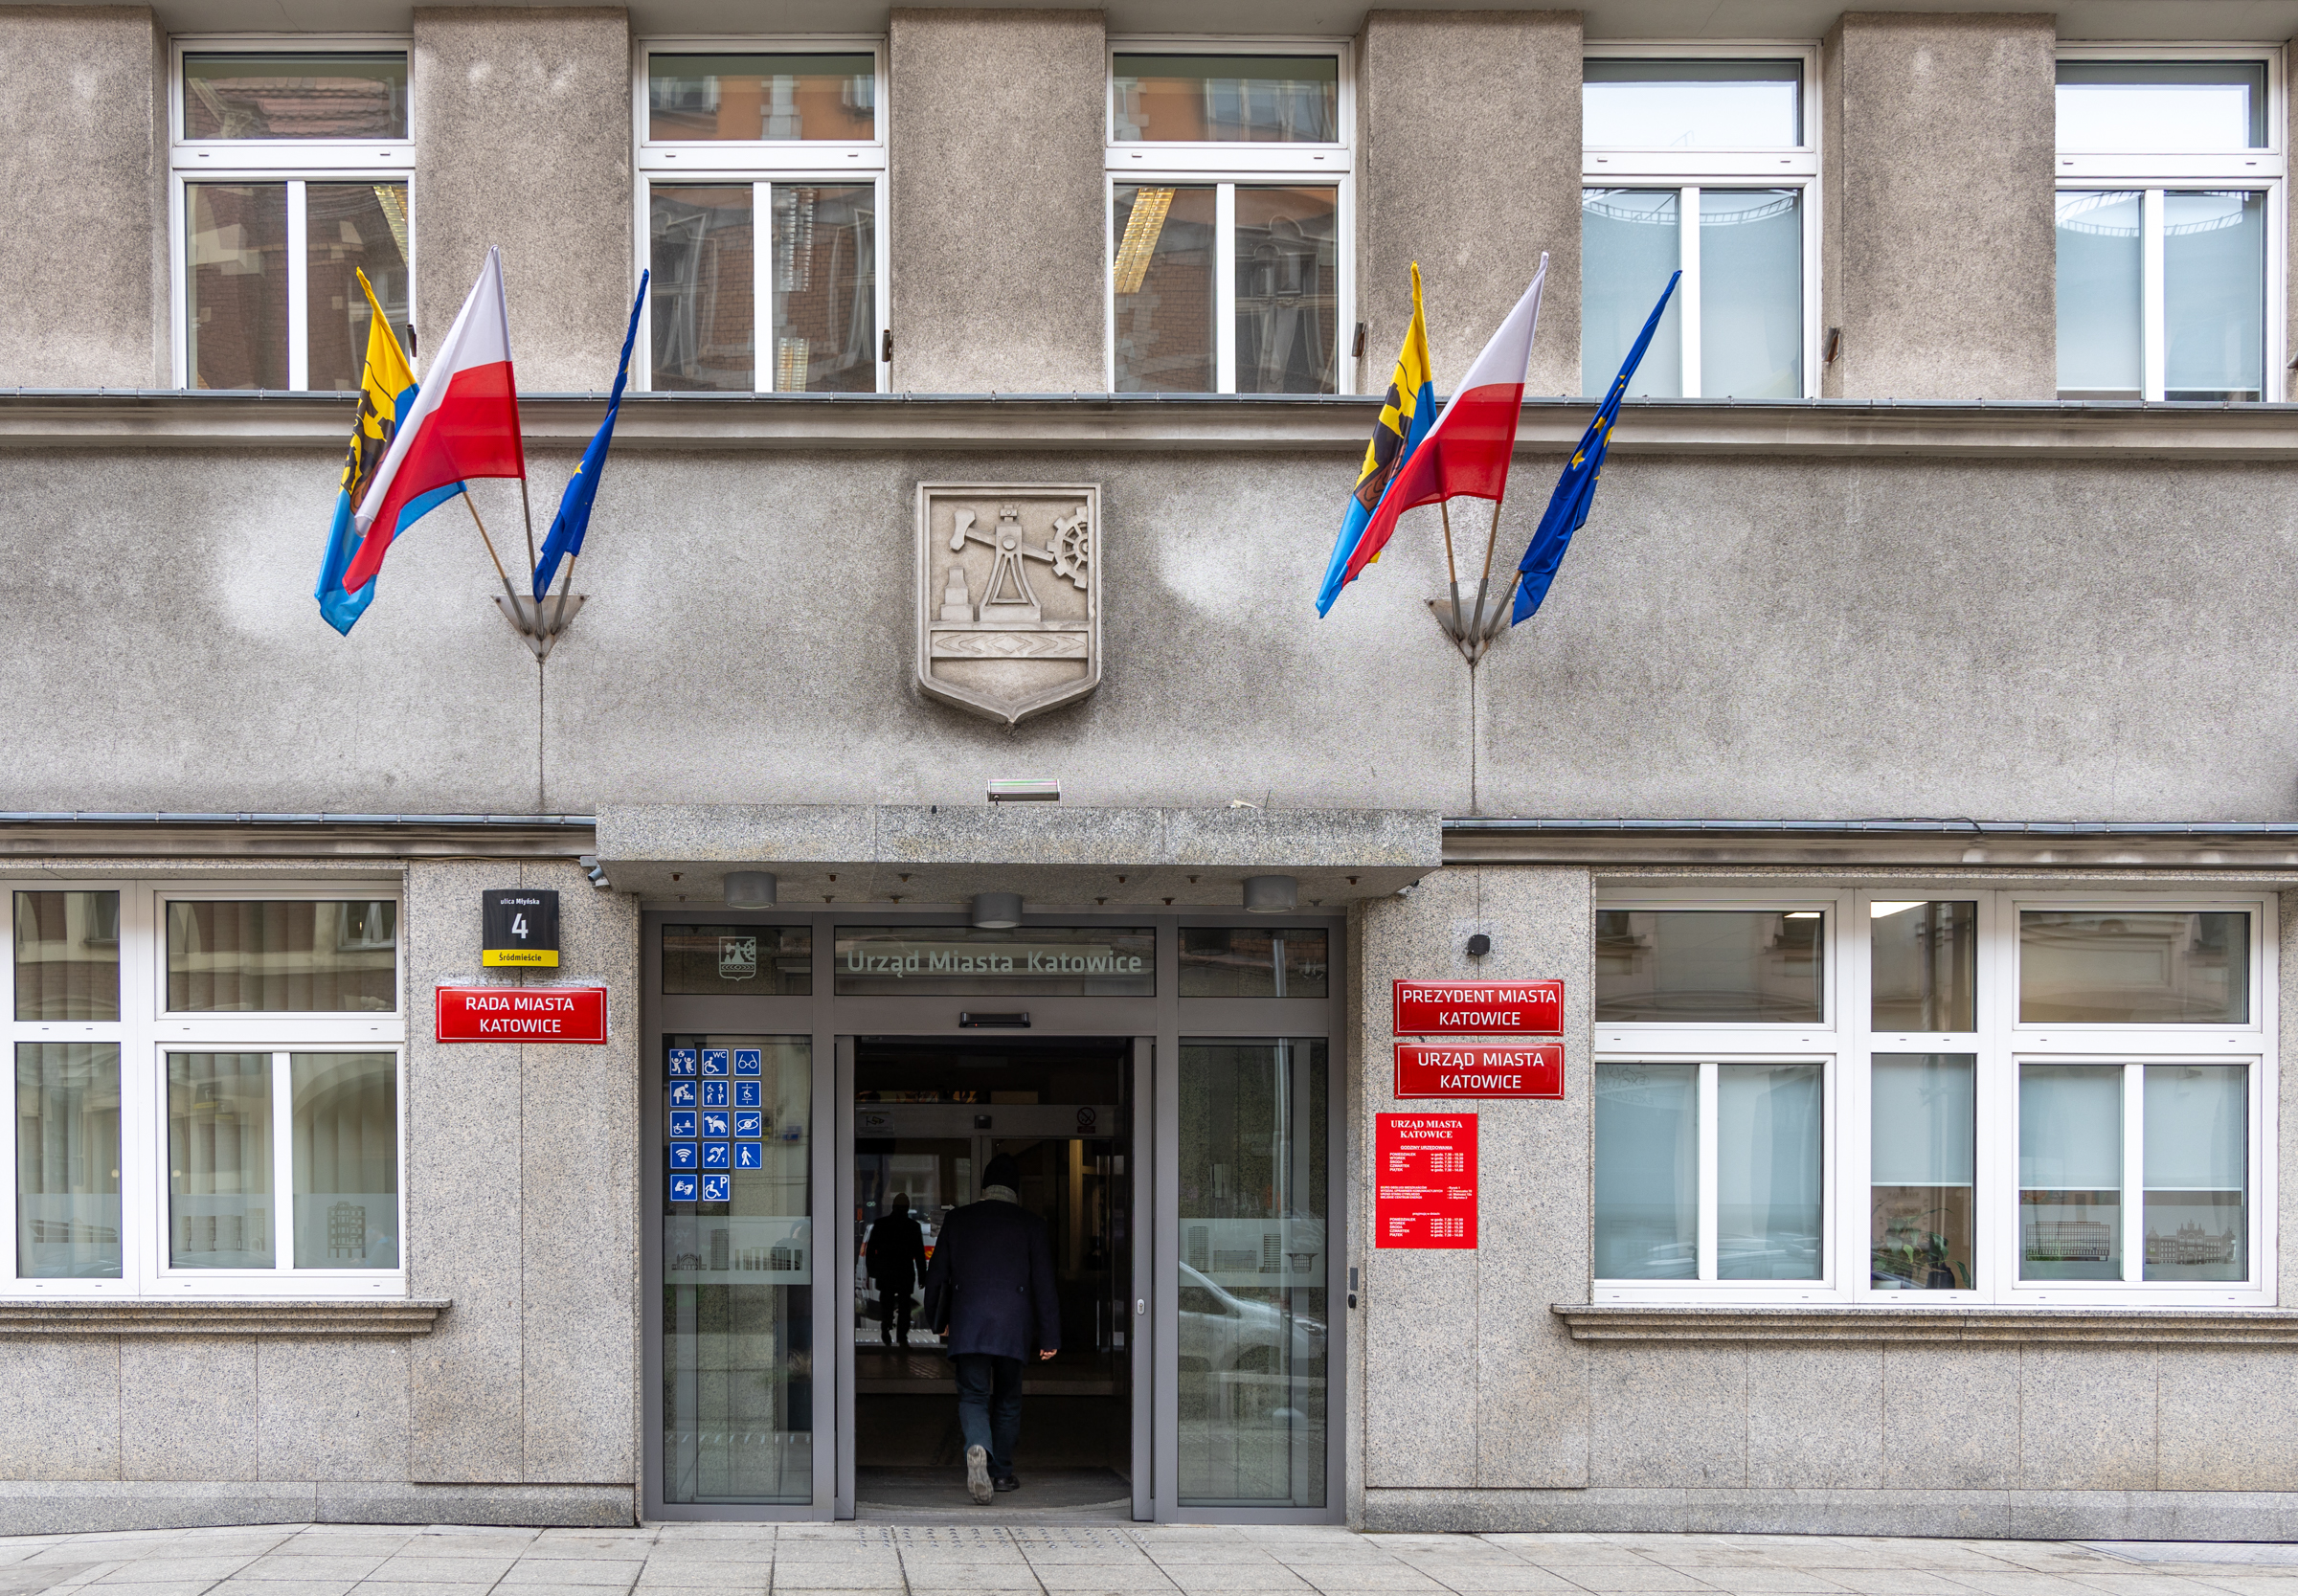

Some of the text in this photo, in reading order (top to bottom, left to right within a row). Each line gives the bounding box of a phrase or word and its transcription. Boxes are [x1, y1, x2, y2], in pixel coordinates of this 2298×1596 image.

[516, 898, 540, 906] Młyńska
[511, 913, 529, 939] 4
[498, 952, 542, 962] Śródmieście
[847, 950, 1142, 978] Urząd Miasta Katowice
[1402, 989, 1557, 1003] PREZYDENT MIASTA
[465, 997, 574, 1012] RADA MIASTA
[480, 1019, 562, 1033] KATOWICE
[1439, 1012, 1521, 1026] KATOWICE
[1418, 1053, 1544, 1070] URZĄD MIASTA
[1440, 1075, 1522, 1089] KATOWICE
[1390, 1120, 1463, 1130] URZĄD MIASTA
[1400, 1130, 1453, 1138] KATOWICE
[720, 1177, 727, 1189] P
